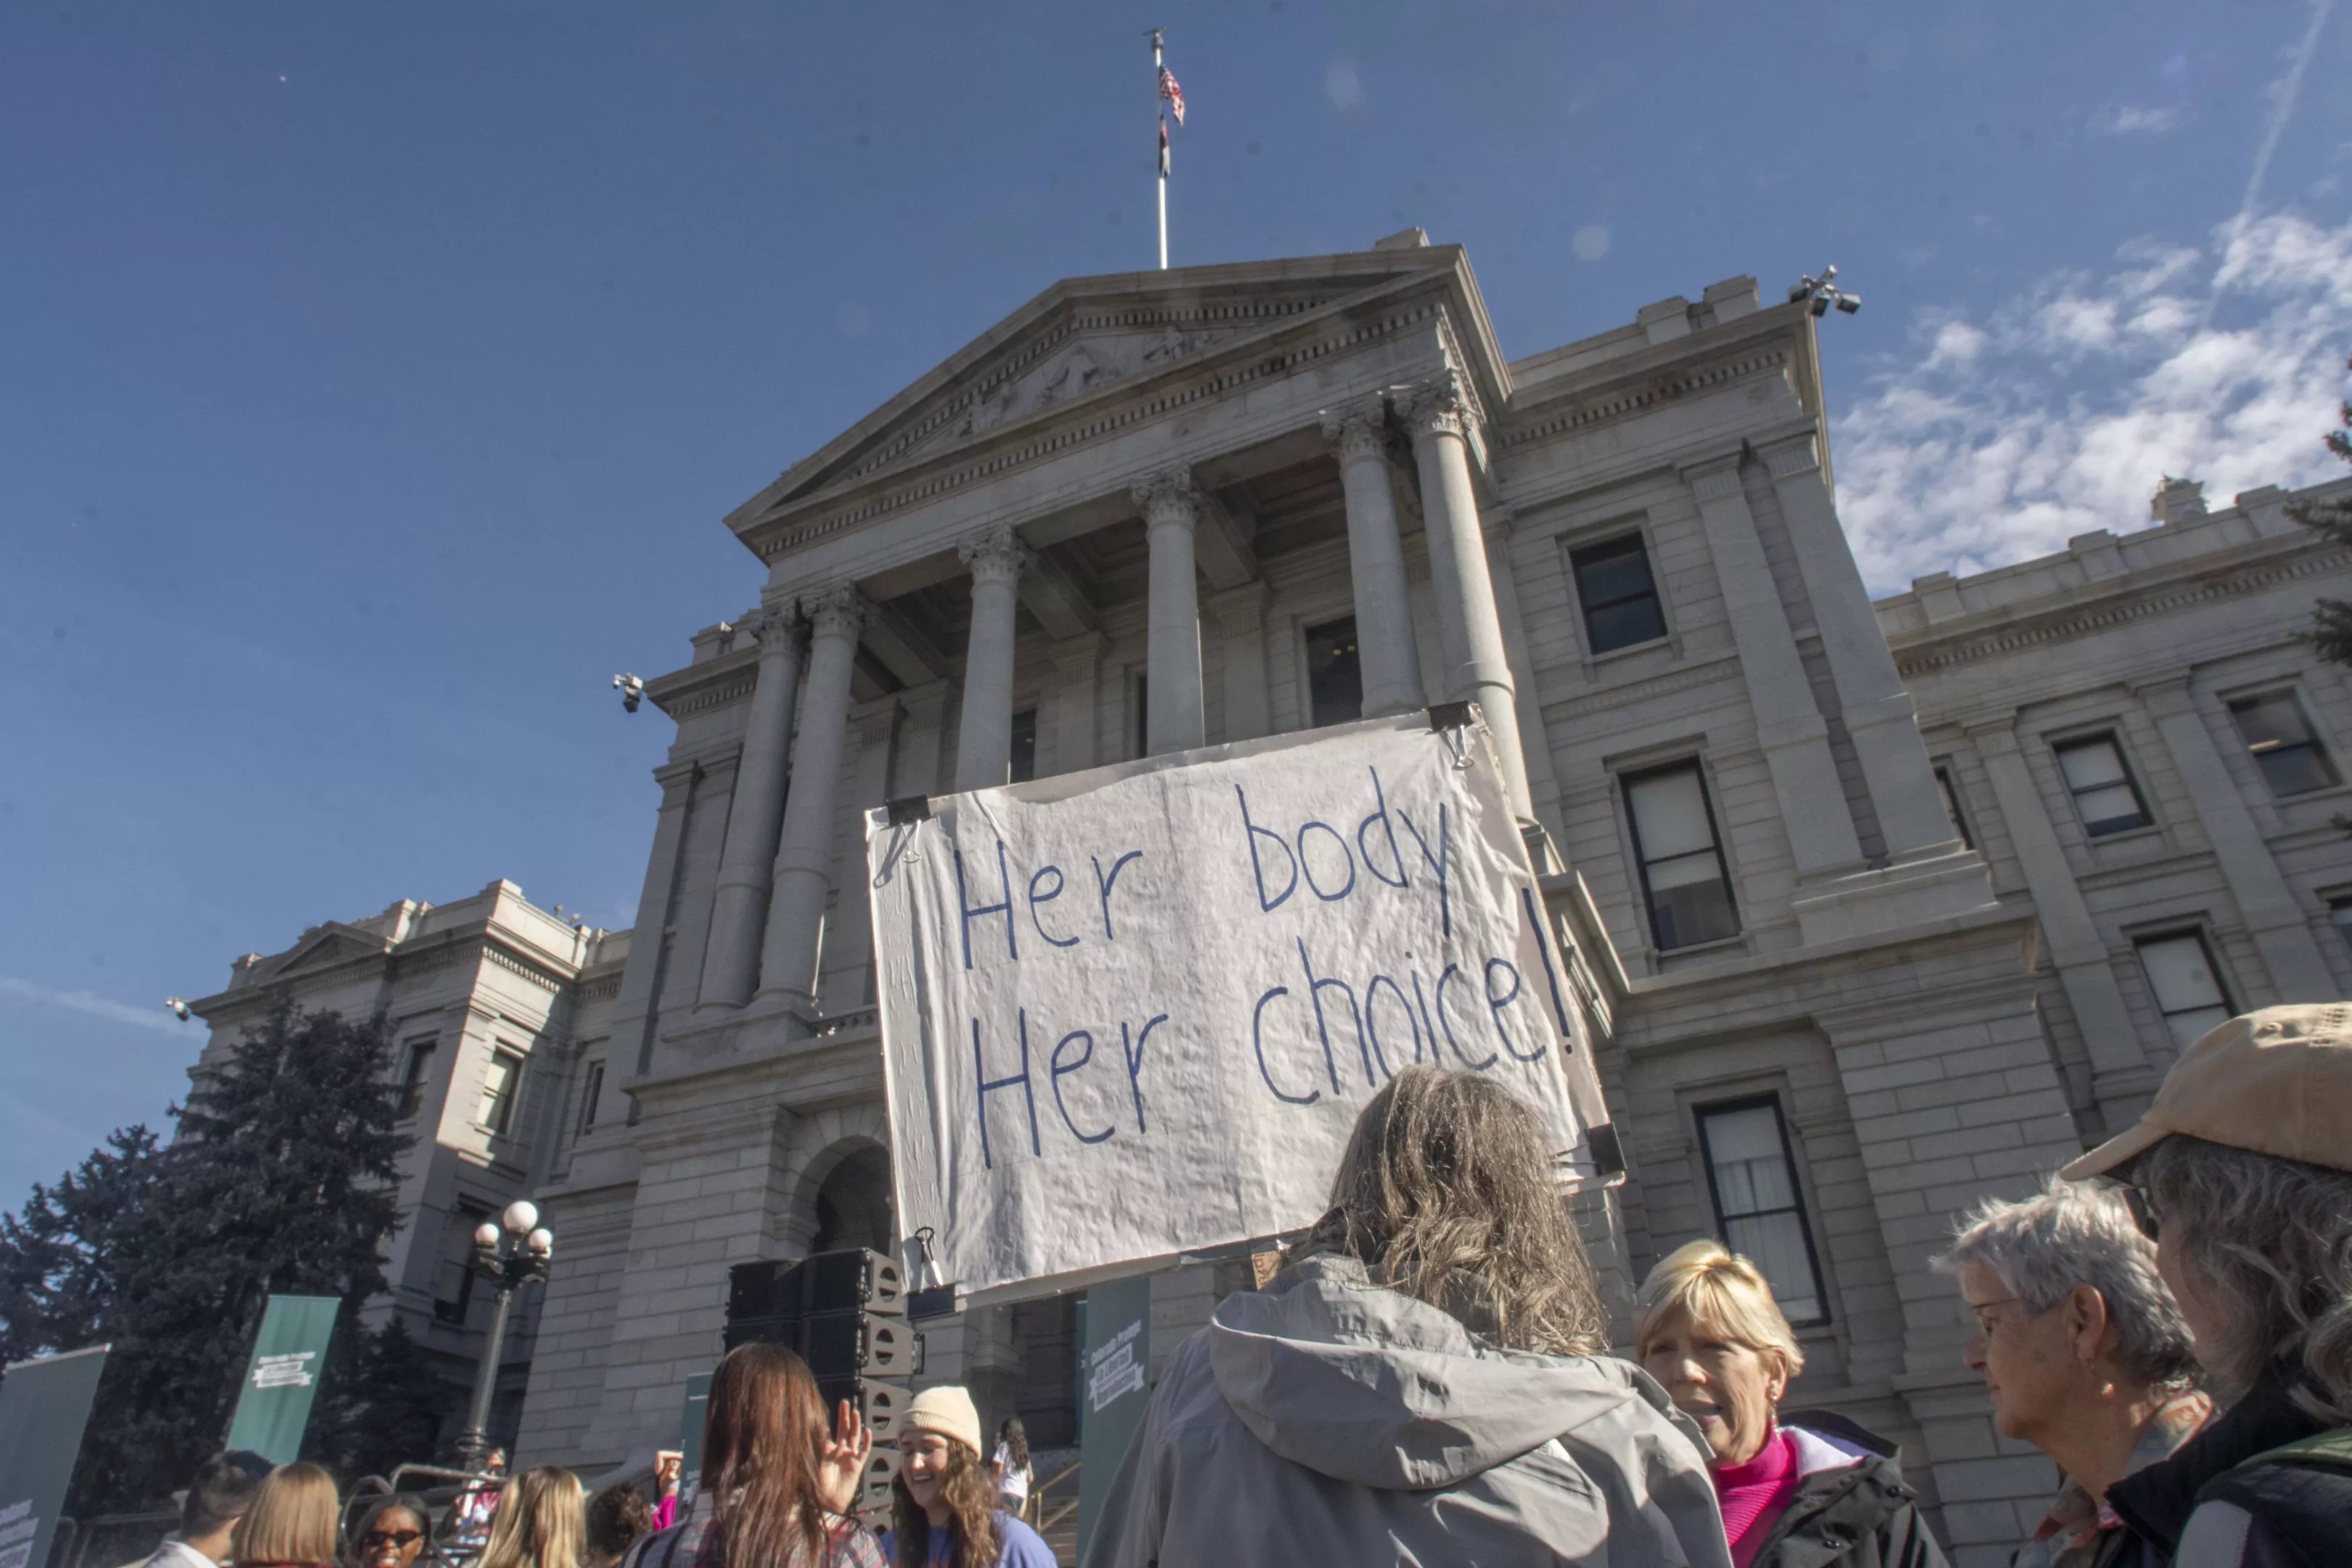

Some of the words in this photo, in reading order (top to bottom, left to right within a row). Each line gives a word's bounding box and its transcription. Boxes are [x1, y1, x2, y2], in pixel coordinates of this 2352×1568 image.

[953, 840, 1143, 971] Her
[1234, 764, 1451, 938] body
[972, 1007, 1169, 1169] Her
[1252, 887, 1575, 1105] choice!
